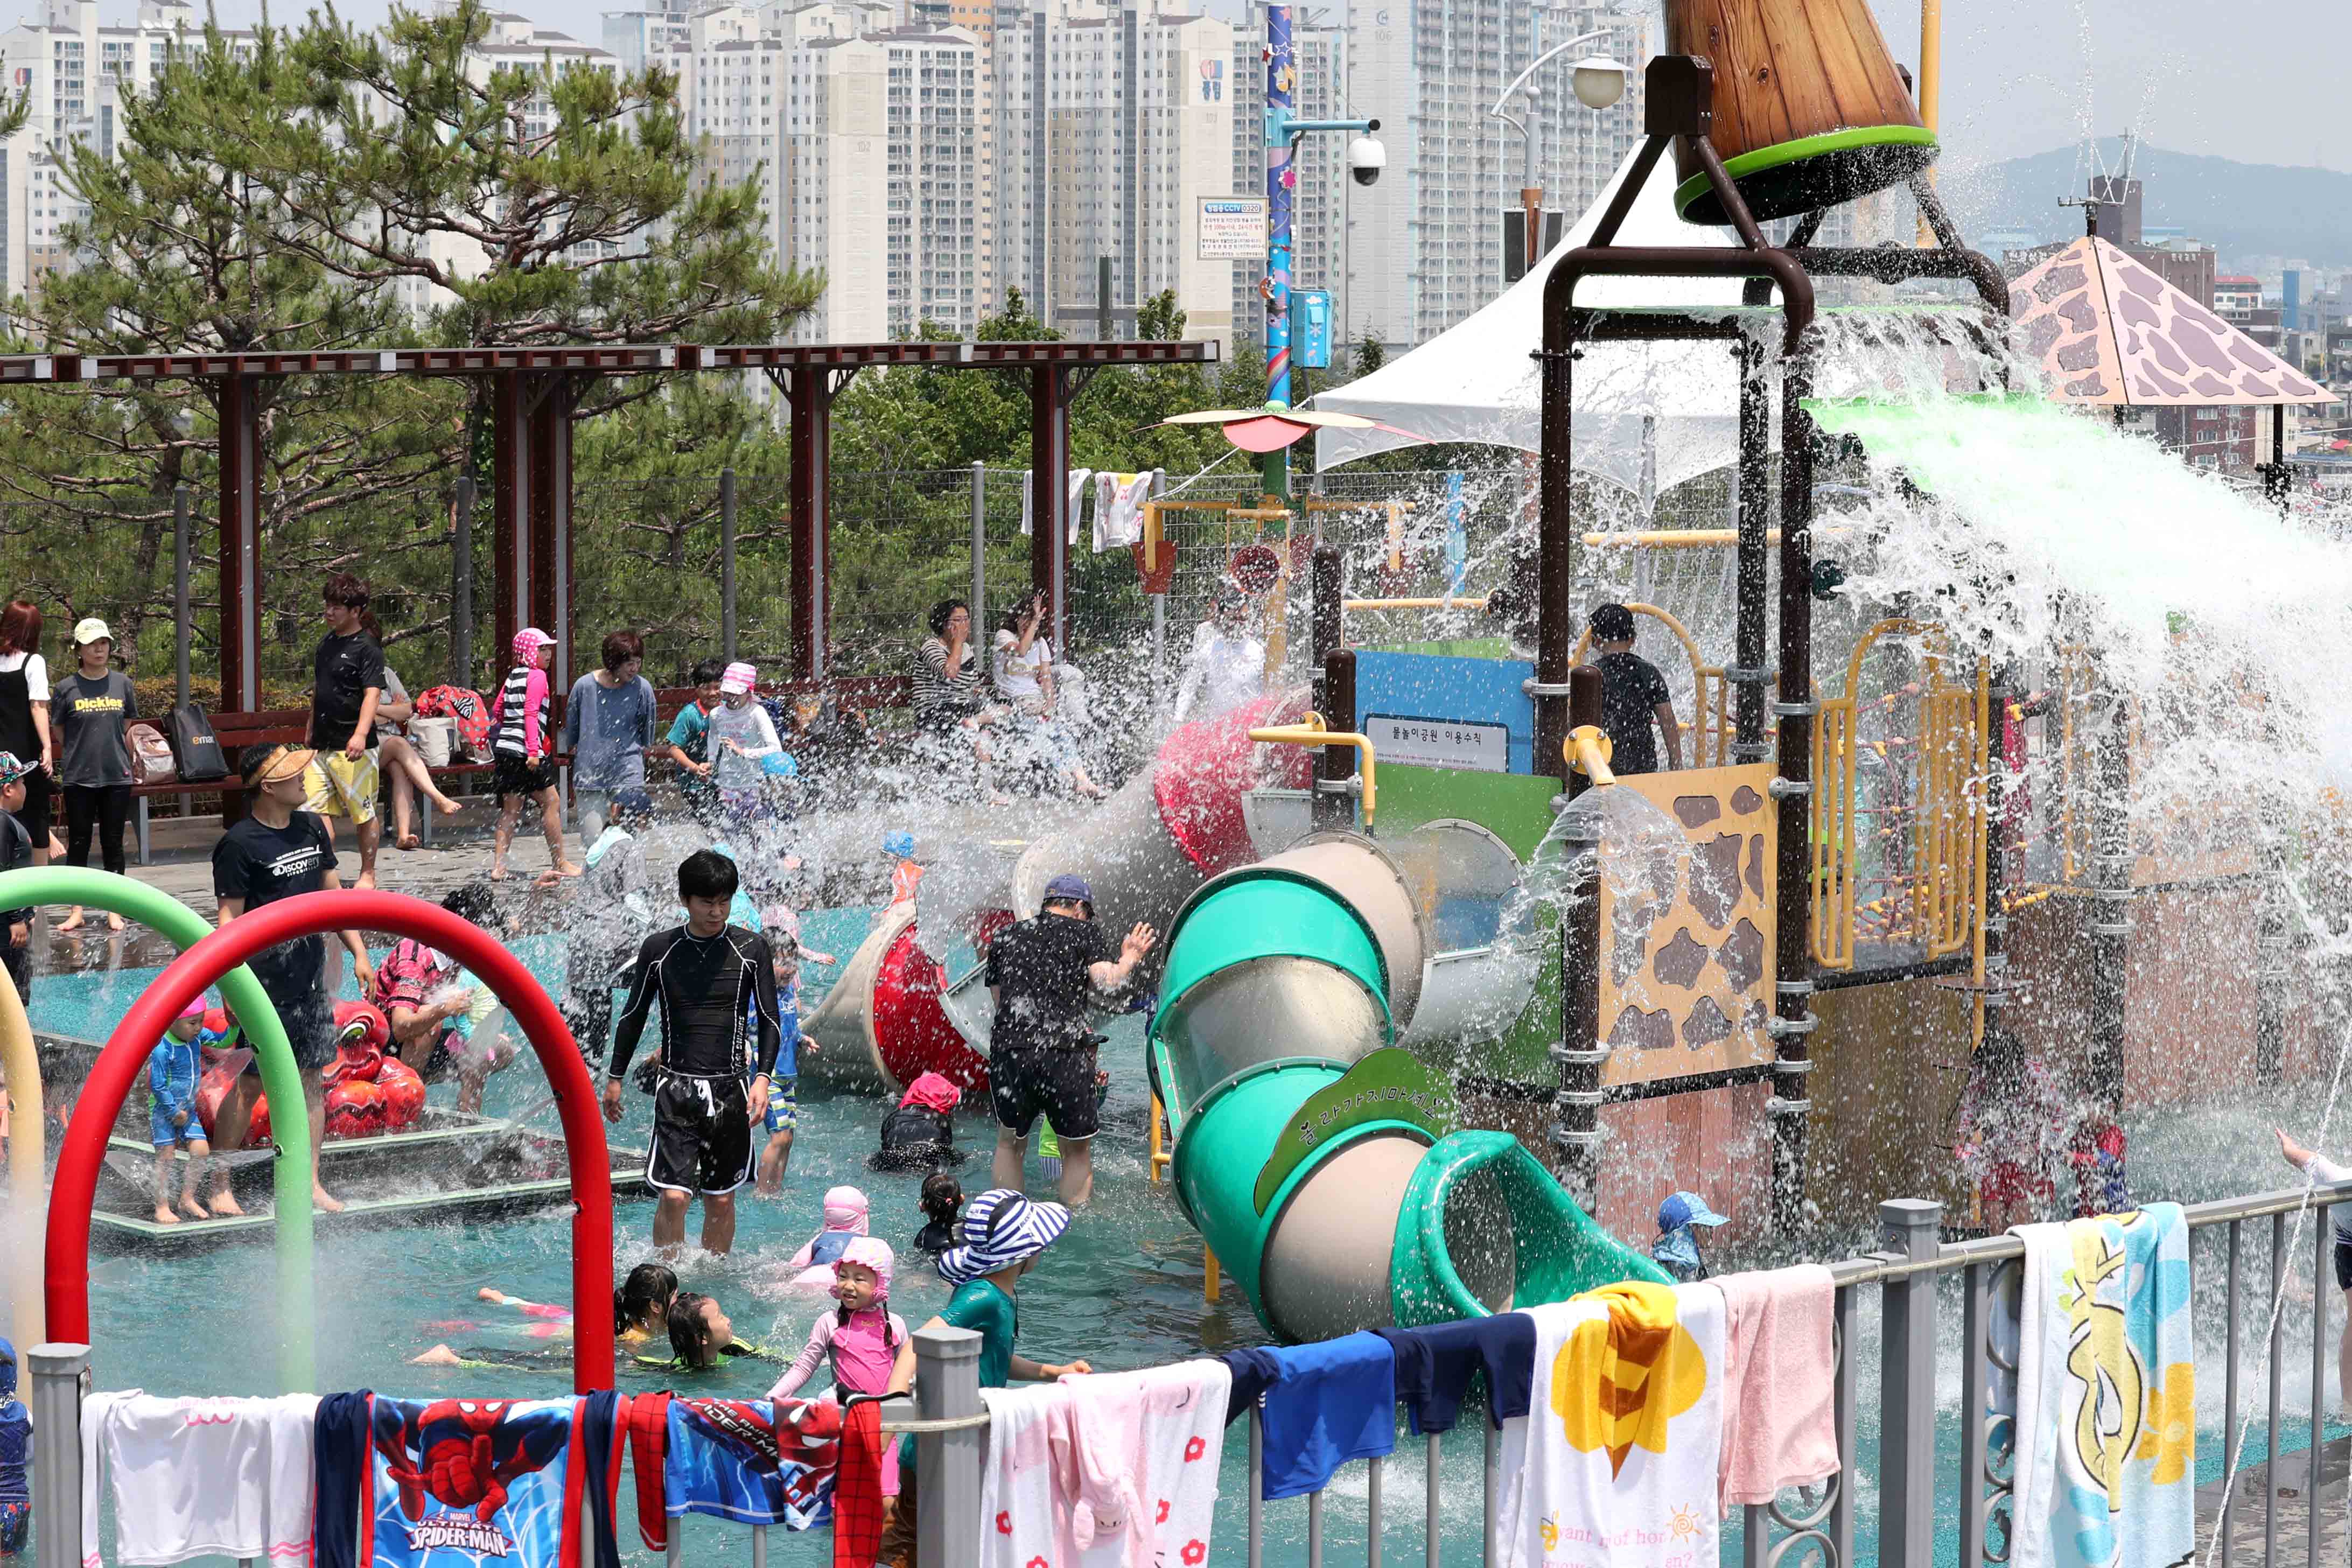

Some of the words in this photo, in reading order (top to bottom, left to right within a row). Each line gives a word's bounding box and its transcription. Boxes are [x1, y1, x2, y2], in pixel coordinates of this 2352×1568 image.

[75, 697, 123, 711] Dickies
[1392, 726, 1438, 742] 물놀이공원
[1445, 731, 1481, 745] 이용수칙
[1299, 1086, 1443, 1146] 올라가지마세요
[450, 1513, 471, 1522] MARVEL
[417, 1520, 501, 1533] ULTIMATE
[409, 1527, 508, 1558] SPIDER-MAN
